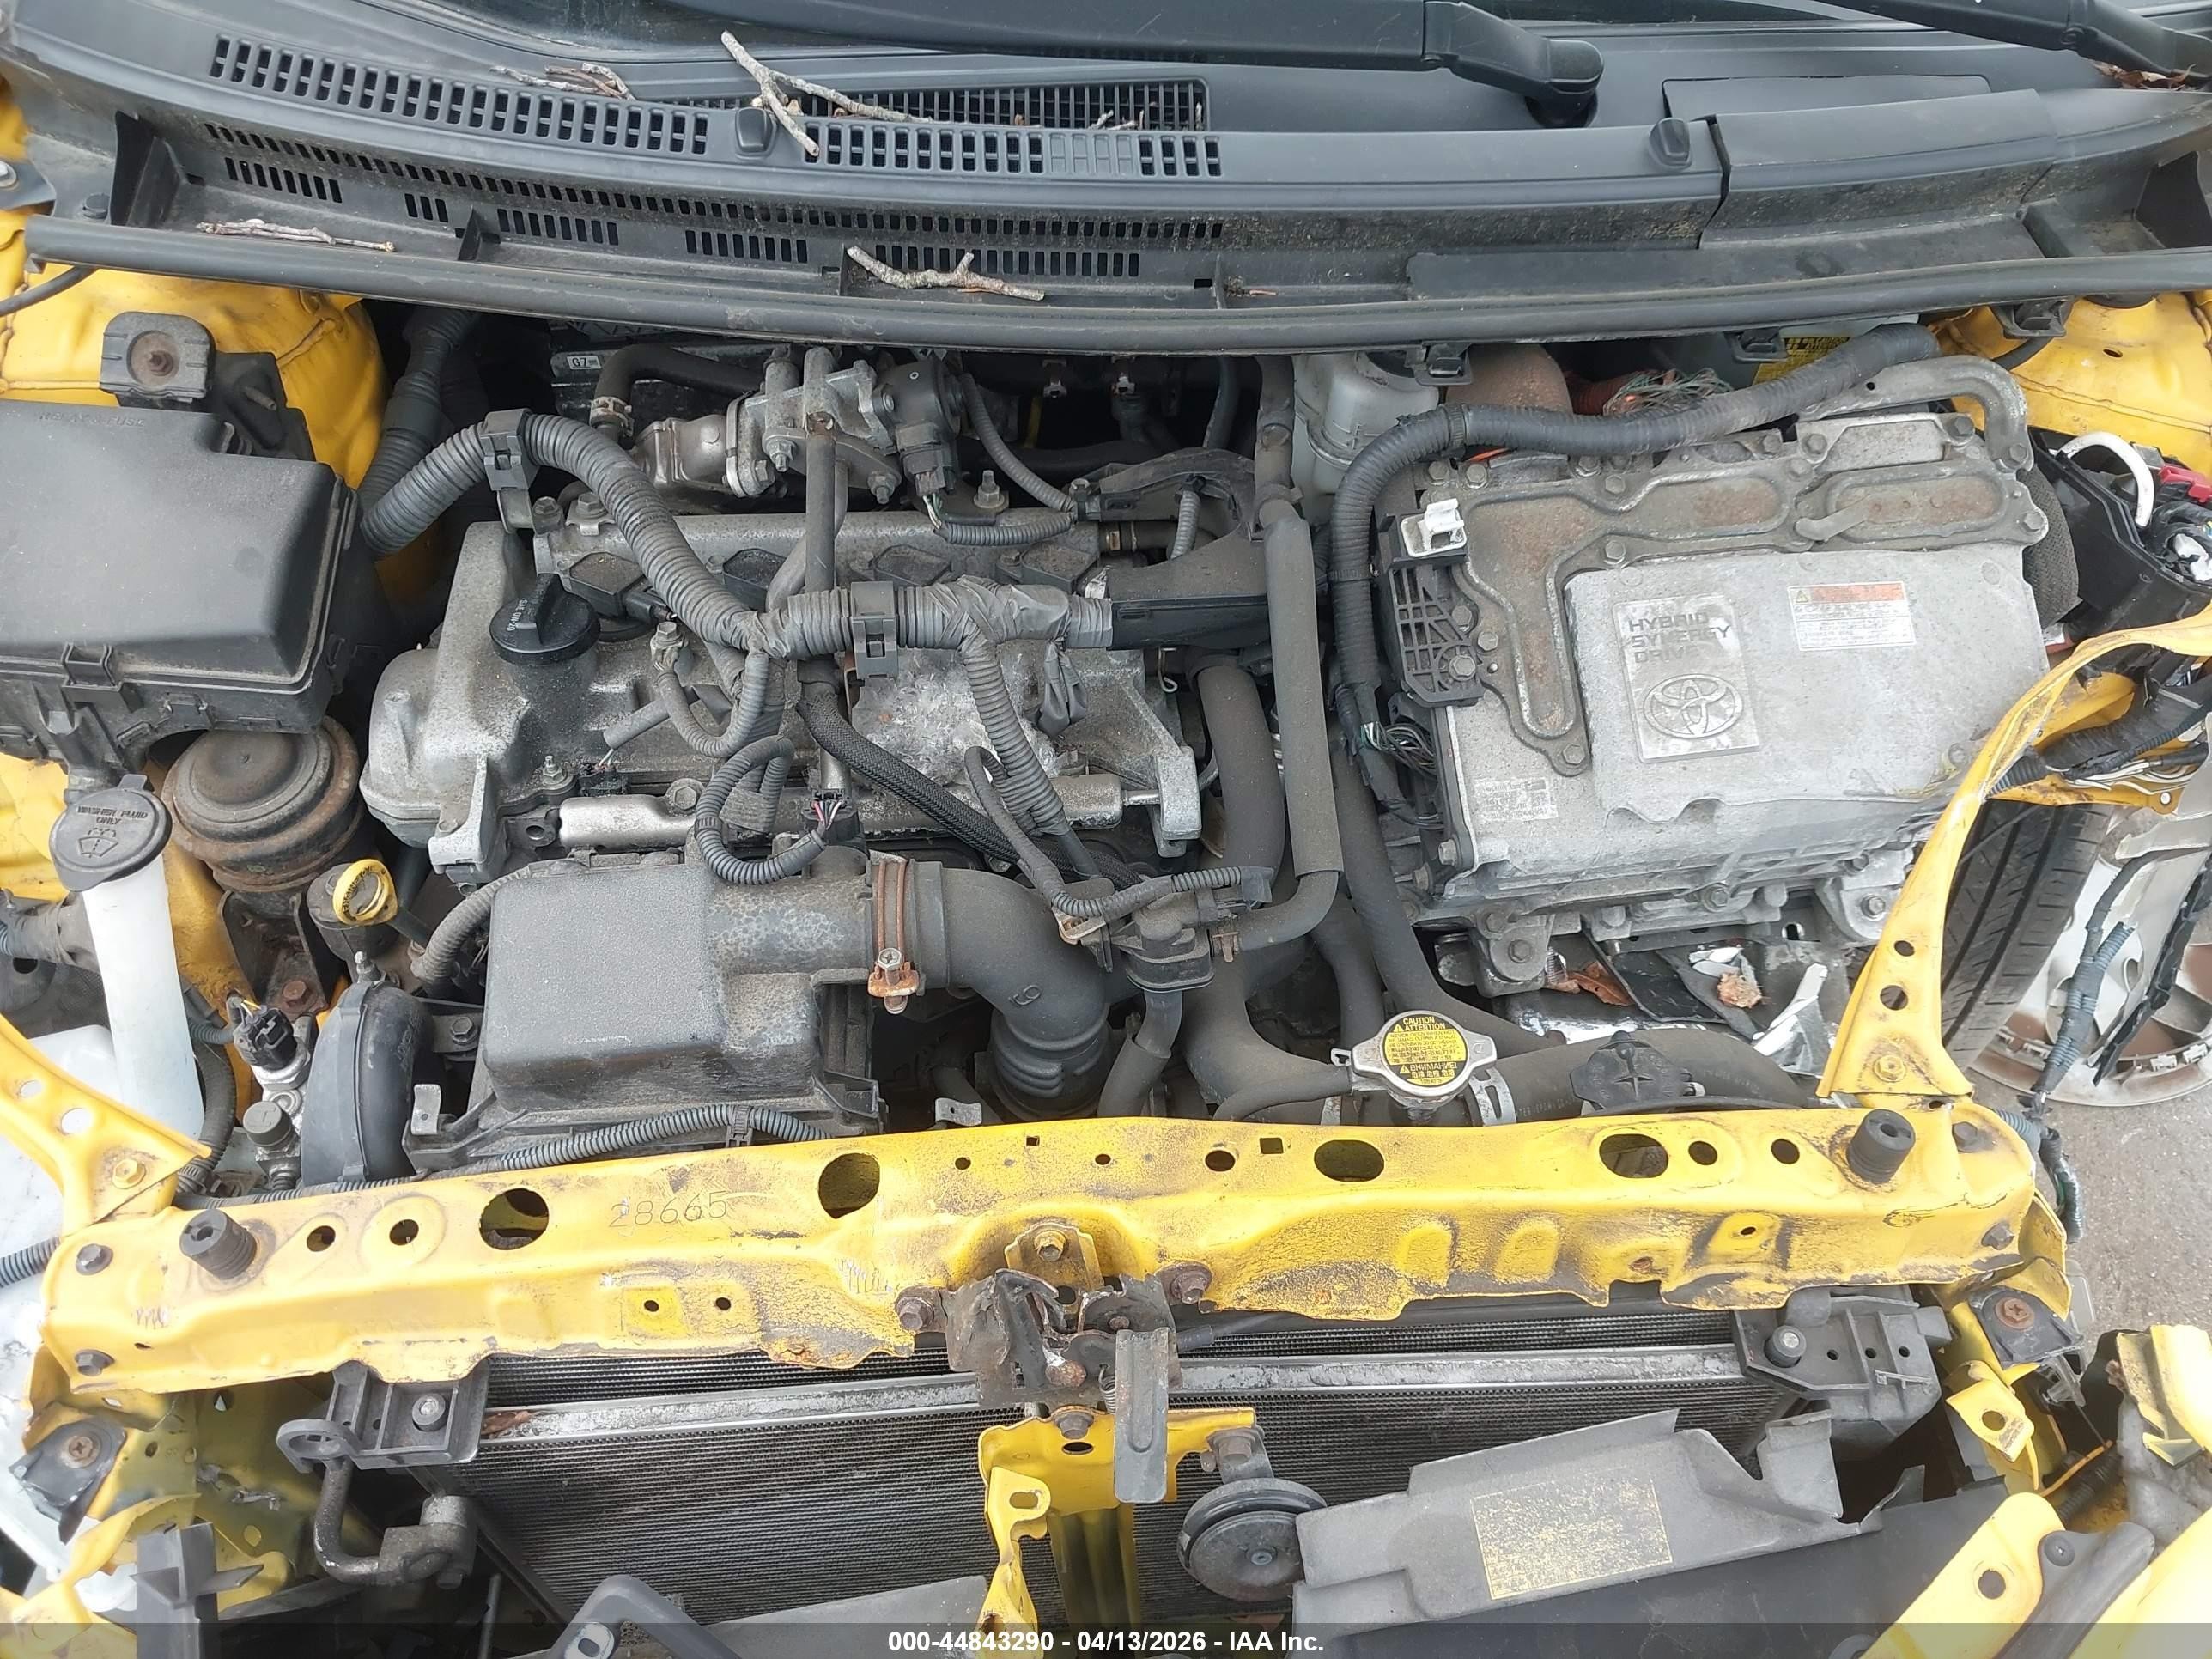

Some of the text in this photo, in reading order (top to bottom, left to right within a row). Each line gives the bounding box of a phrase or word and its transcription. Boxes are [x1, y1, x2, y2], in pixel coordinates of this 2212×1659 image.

[1629, 613, 1709, 632] HYBRID
[1632, 625, 1732, 647] SYNERGY
[120, 810, 148, 819] FLUID
[96, 817, 122, 825] ONLY
[1403, 1016, 1435, 1025] CAUTION
[1405, 1022, 1445, 1031] ATTENTION
[609, 1190, 727, 1227] 28665
